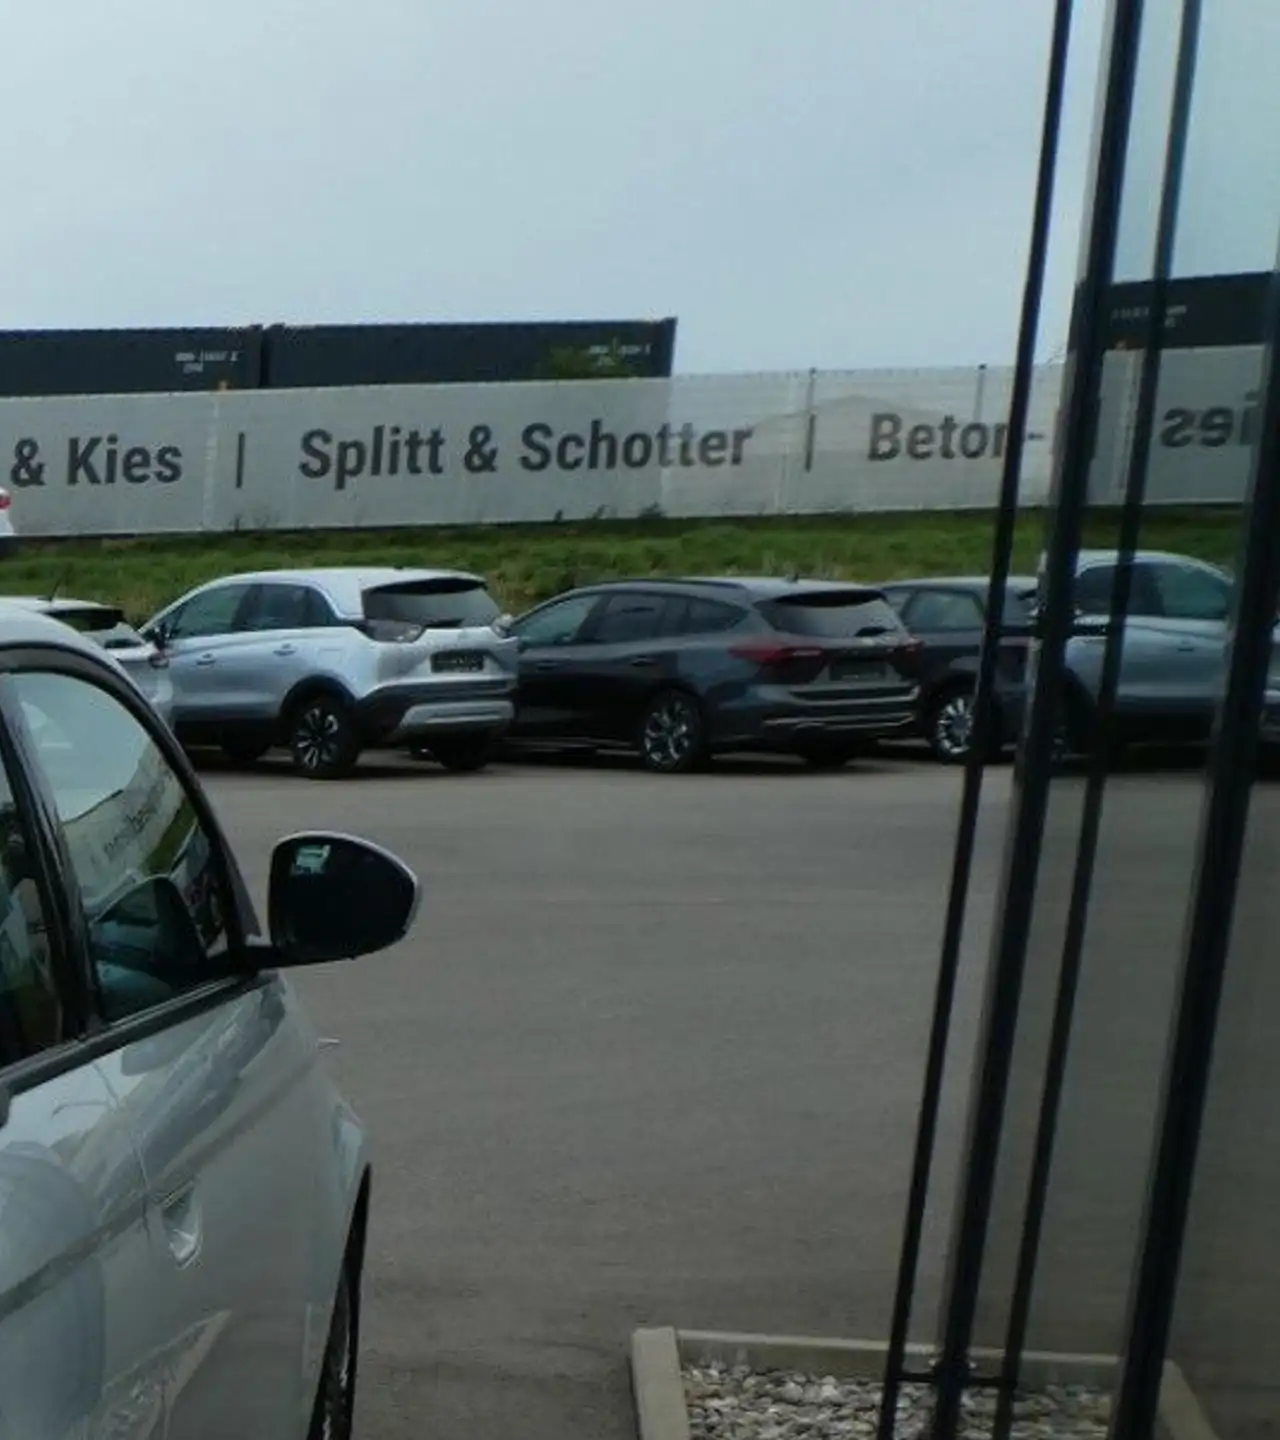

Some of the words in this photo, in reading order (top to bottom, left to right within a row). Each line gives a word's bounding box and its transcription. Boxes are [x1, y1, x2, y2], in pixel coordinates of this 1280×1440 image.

[11, 437, 46, 487] &
[67, 434, 183, 486] Kies
[298, 426, 445, 490] Splitt
[463, 424, 498, 473] &
[520, 420, 754, 472] Schotter
